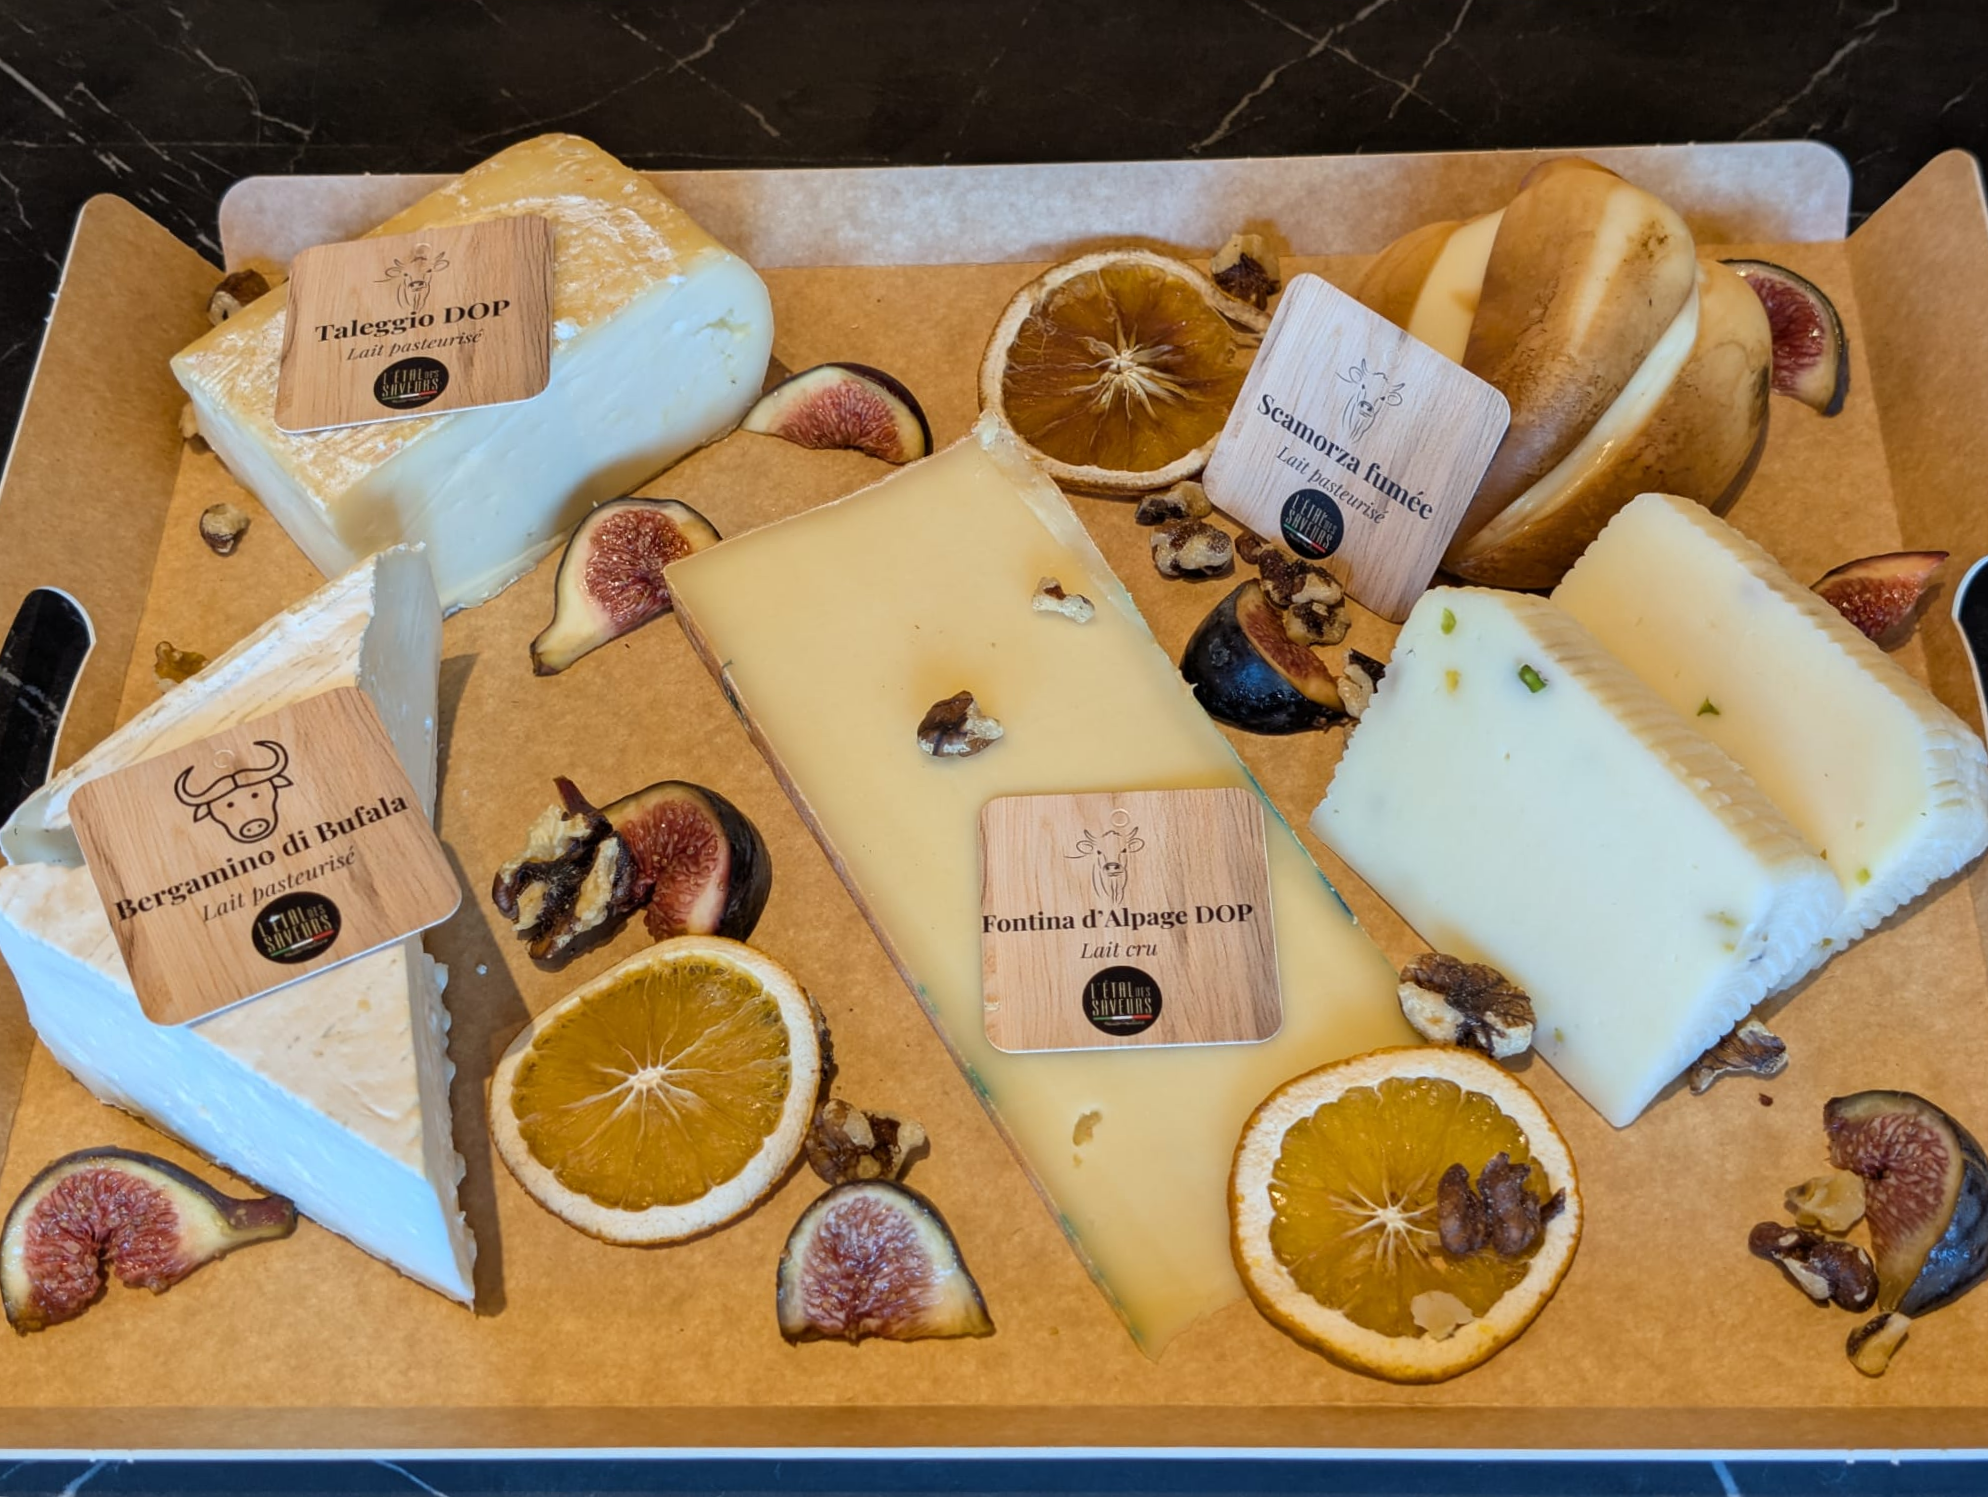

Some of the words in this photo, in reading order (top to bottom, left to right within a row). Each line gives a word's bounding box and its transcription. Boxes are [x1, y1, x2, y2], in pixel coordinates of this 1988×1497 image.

[314, 310, 435, 343] Taleggio
[444, 299, 511, 325] DOP
[346, 345, 386, 361] Lait
[388, 328, 485, 356] pasteurisé
[382, 377, 439, 398] SAVEURS
[1256, 393, 1361, 475] Scamorza
[1362, 461, 1434, 521] fumée
[1275, 445, 1308, 476] Lait
[1307, 467, 1390, 525] pasteurisé
[1284, 509, 1333, 549] SAVEURS
[113, 848, 276, 922] Bergamino
[282, 829, 311, 860] di
[314, 795, 409, 842] Bufala
[202, 896, 247, 923] Lait
[251, 845, 358, 907] pasteurisé
[264, 914, 333, 954] SAVEURS
[982, 911, 1076, 934] Fontina
[1081, 906, 1189, 932] d'Alpage
[1195, 903, 1254, 925] DOP
[1080, 940, 1122, 960] Lait
[1125, 942, 1159, 959] cru
[1091, 997, 1153, 1016] SAVEURS
